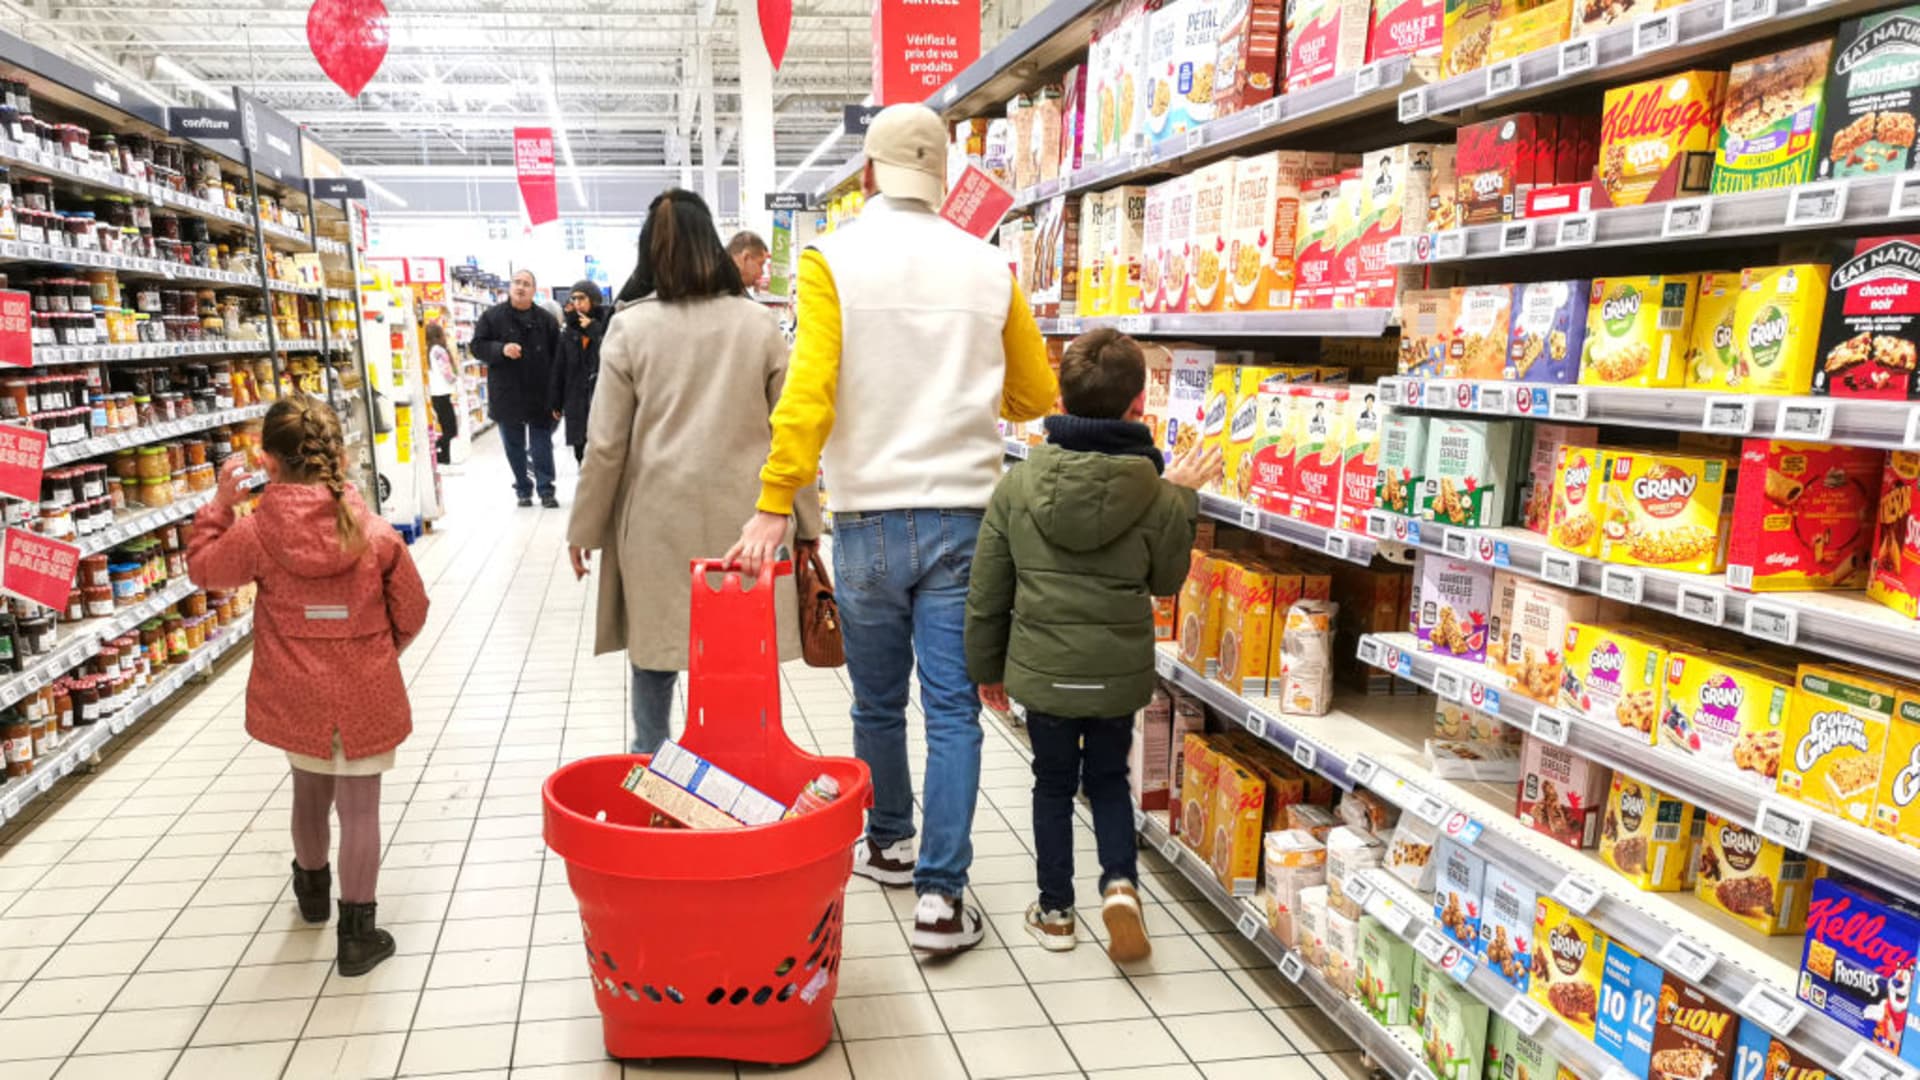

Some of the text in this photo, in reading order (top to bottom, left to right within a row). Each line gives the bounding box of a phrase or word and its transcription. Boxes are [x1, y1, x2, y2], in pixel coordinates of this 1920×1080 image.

[906, 34, 957, 46] Vérifiez le
[1390, 14, 1437, 40] QUAKER
[1398, 30, 1426, 46] OATS
[905, 48, 958, 61] prix de vos
[1843, 36, 1870, 67] EAT
[910, 61, 953, 75] produits
[182, 117, 229, 129] confiture
[1839, 258, 1867, 284] EAT
[1859, 281, 1909, 297] chocolat
[1602, 289, 1644, 321] GRANY
[1870, 298, 1894, 310] noir
[1748, 313, 1789, 348] GRANY
[1616, 459, 1631, 474] LU
[1633, 473, 1698, 500] GRANY
[1699, 682, 1745, 709] GRANY
[1719, 825, 1763, 855] GRANY
[1549, 928, 1587, 962] GRANY
[1834, 959, 1880, 998] FROSTIES
[1602, 983, 1626, 1022] 10
[1632, 989, 1656, 1033] 12
[1673, 1006, 1732, 1040] LION
[1737, 1045, 1764, 1080] 12
